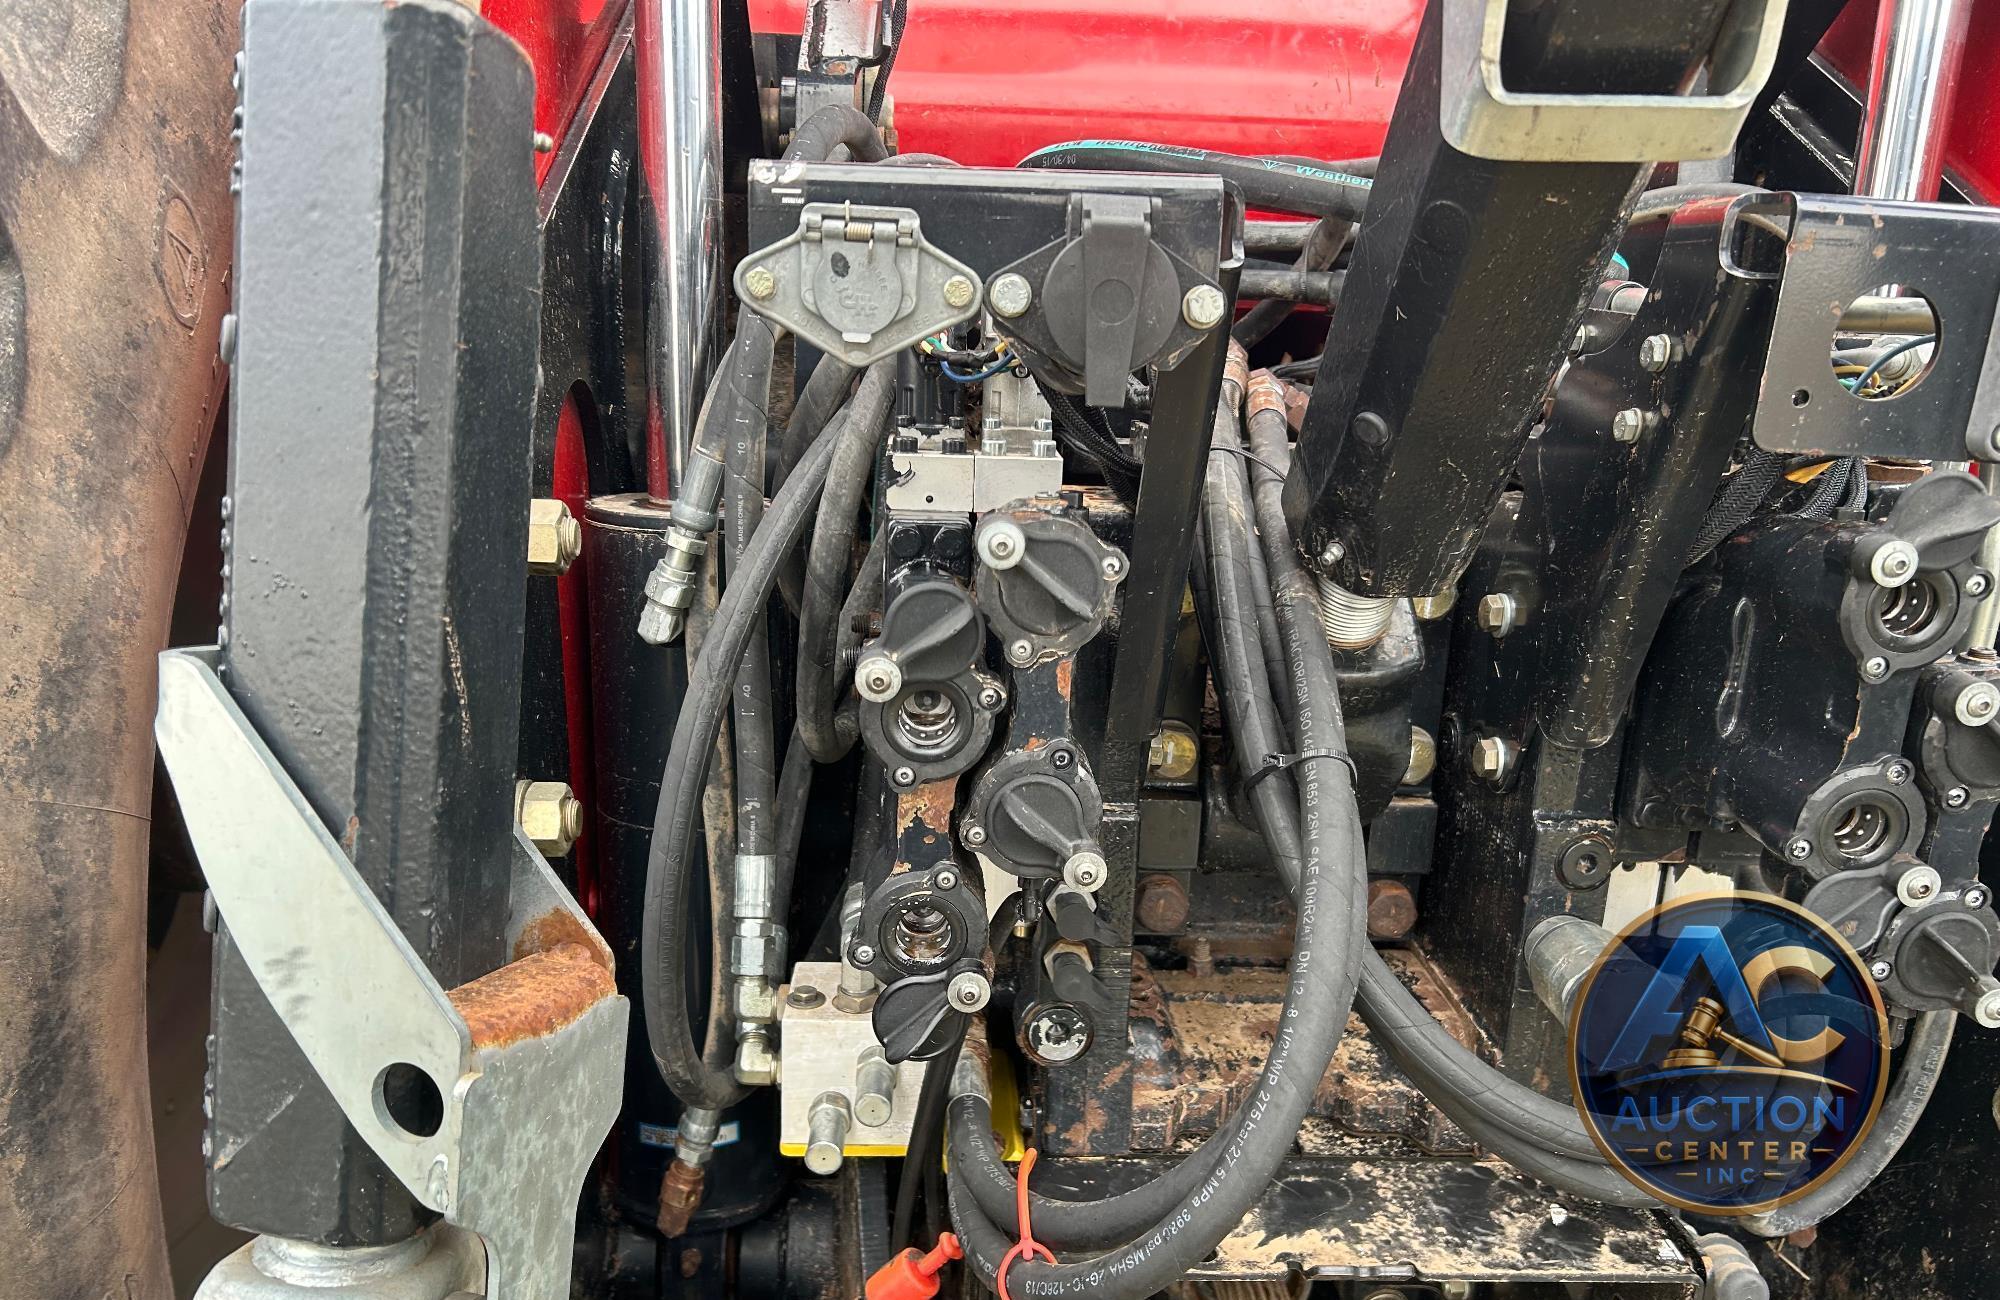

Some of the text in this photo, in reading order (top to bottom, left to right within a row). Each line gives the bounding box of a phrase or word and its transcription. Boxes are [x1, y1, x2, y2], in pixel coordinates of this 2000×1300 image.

[1300, 706, 1312, 730] ISO
[1304, 760, 1318, 782] EN
[1307, 782, 1319, 807] 853
[1308, 811, 1320, 841] 2SN
[1295, 951, 1311, 974] DN
[1267, 1059, 1284, 1086] WP
[1250, 1090, 1271, 1122] 275
[1236, 1120, 1257, 1147] bar
[1191, 1176, 1220, 1208] MPa
[1108, 1249, 1146, 1278] MSHA
